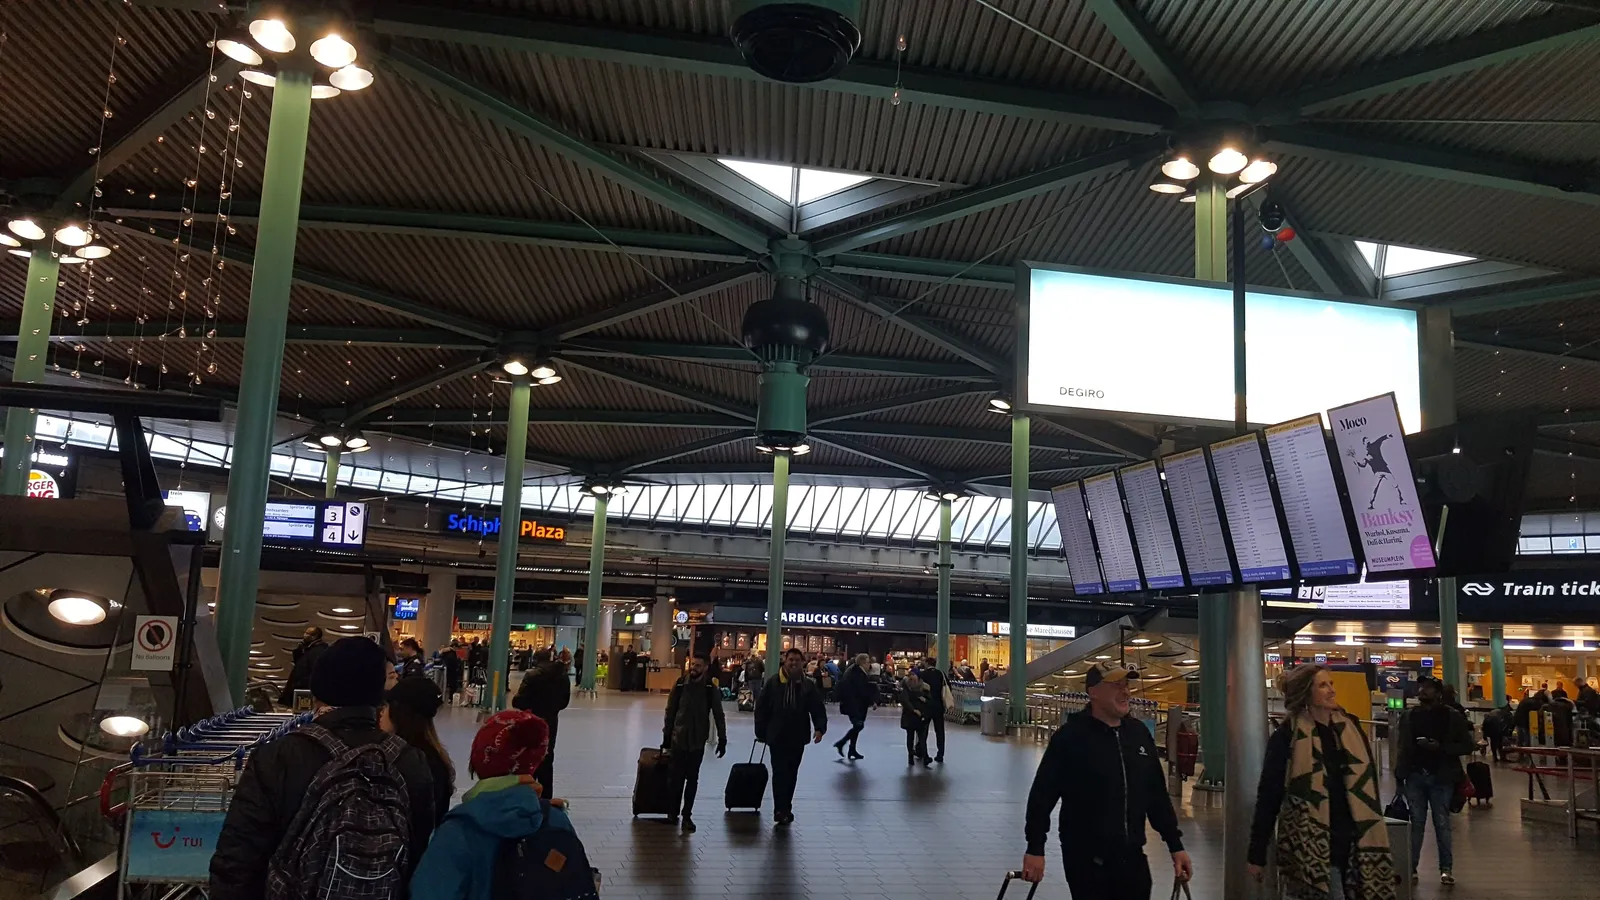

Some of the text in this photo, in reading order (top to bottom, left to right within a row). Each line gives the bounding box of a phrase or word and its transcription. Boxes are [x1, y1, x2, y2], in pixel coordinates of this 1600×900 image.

[1059, 386, 1105, 399] DEGIRO
[1339, 416, 1367, 431] Moco
[28, 480, 54, 490] RGER
[329, 511, 337, 522] 3
[1361, 508, 1415, 529] Banksy
[448, 513, 565, 540] Schiph Plaza
[328, 531, 336, 541] 4
[1301, 589, 1308, 598] 2
[1503, 582, 1555, 596] Train
[764, 611, 885, 627] SARBUCKS COFFEE
[183, 837, 203, 847] TUI
